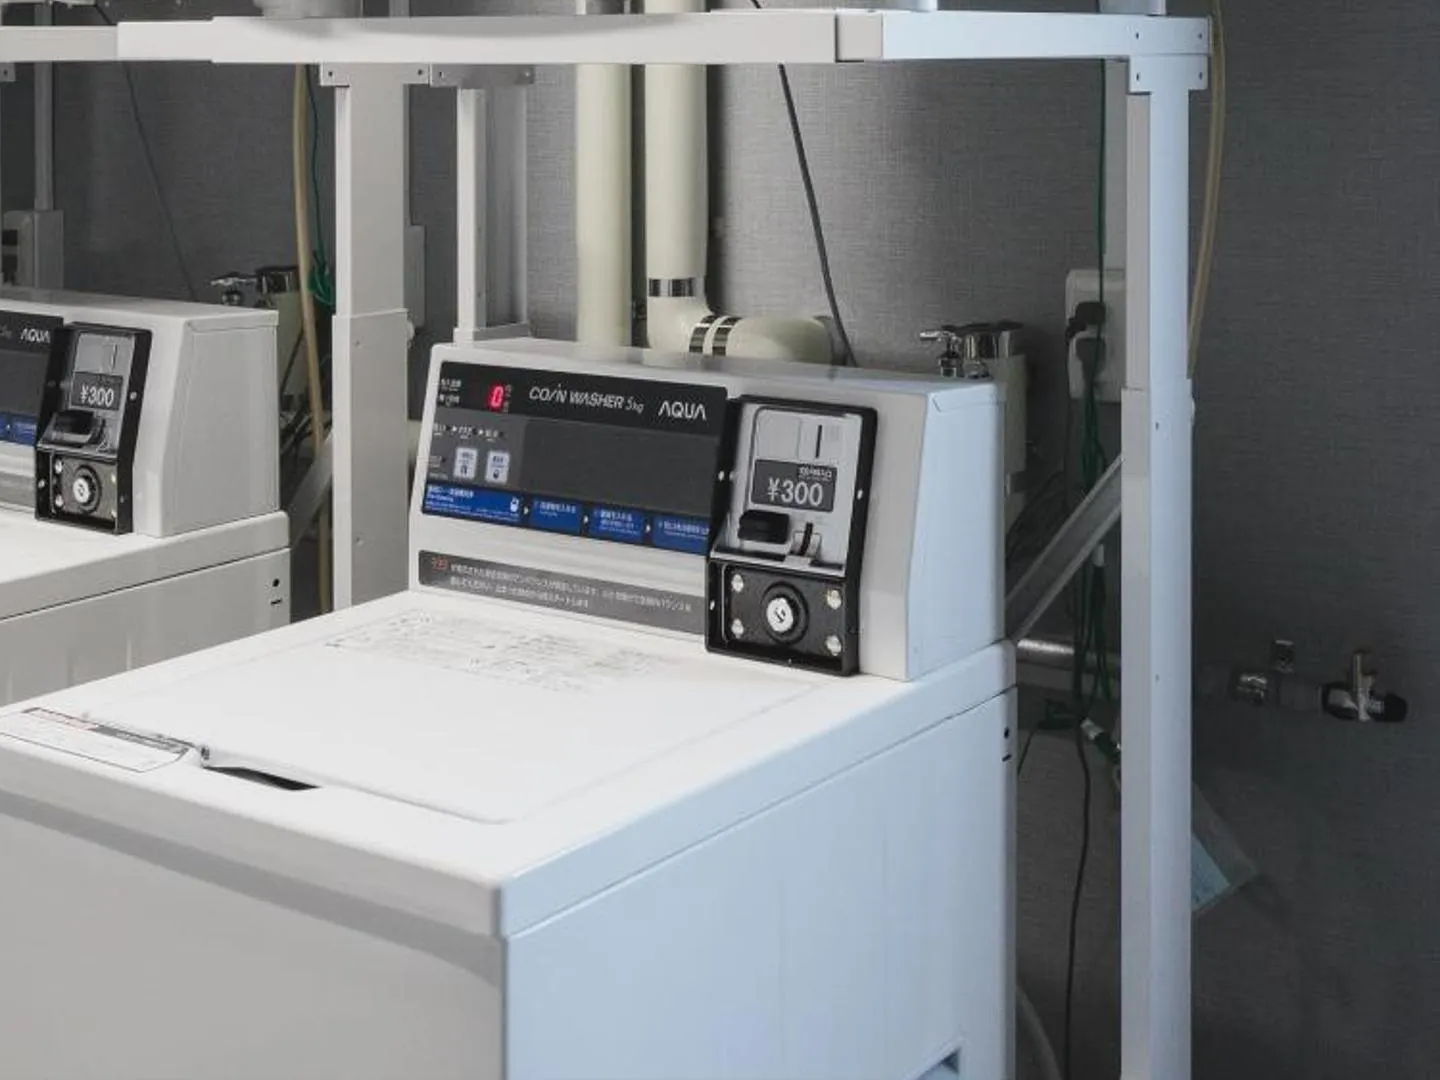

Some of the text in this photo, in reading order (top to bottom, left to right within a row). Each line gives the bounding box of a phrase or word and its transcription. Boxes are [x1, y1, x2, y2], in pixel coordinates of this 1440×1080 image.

[20, 327, 51, 344] AQUA
[79, 382, 114, 408] ¥300
[490, 385, 505, 408] 0
[529, 382, 568, 404] COIN
[569, 390, 625, 410] WASHER
[658, 399, 708, 422] AQUA
[767, 476, 824, 507] ¥300
